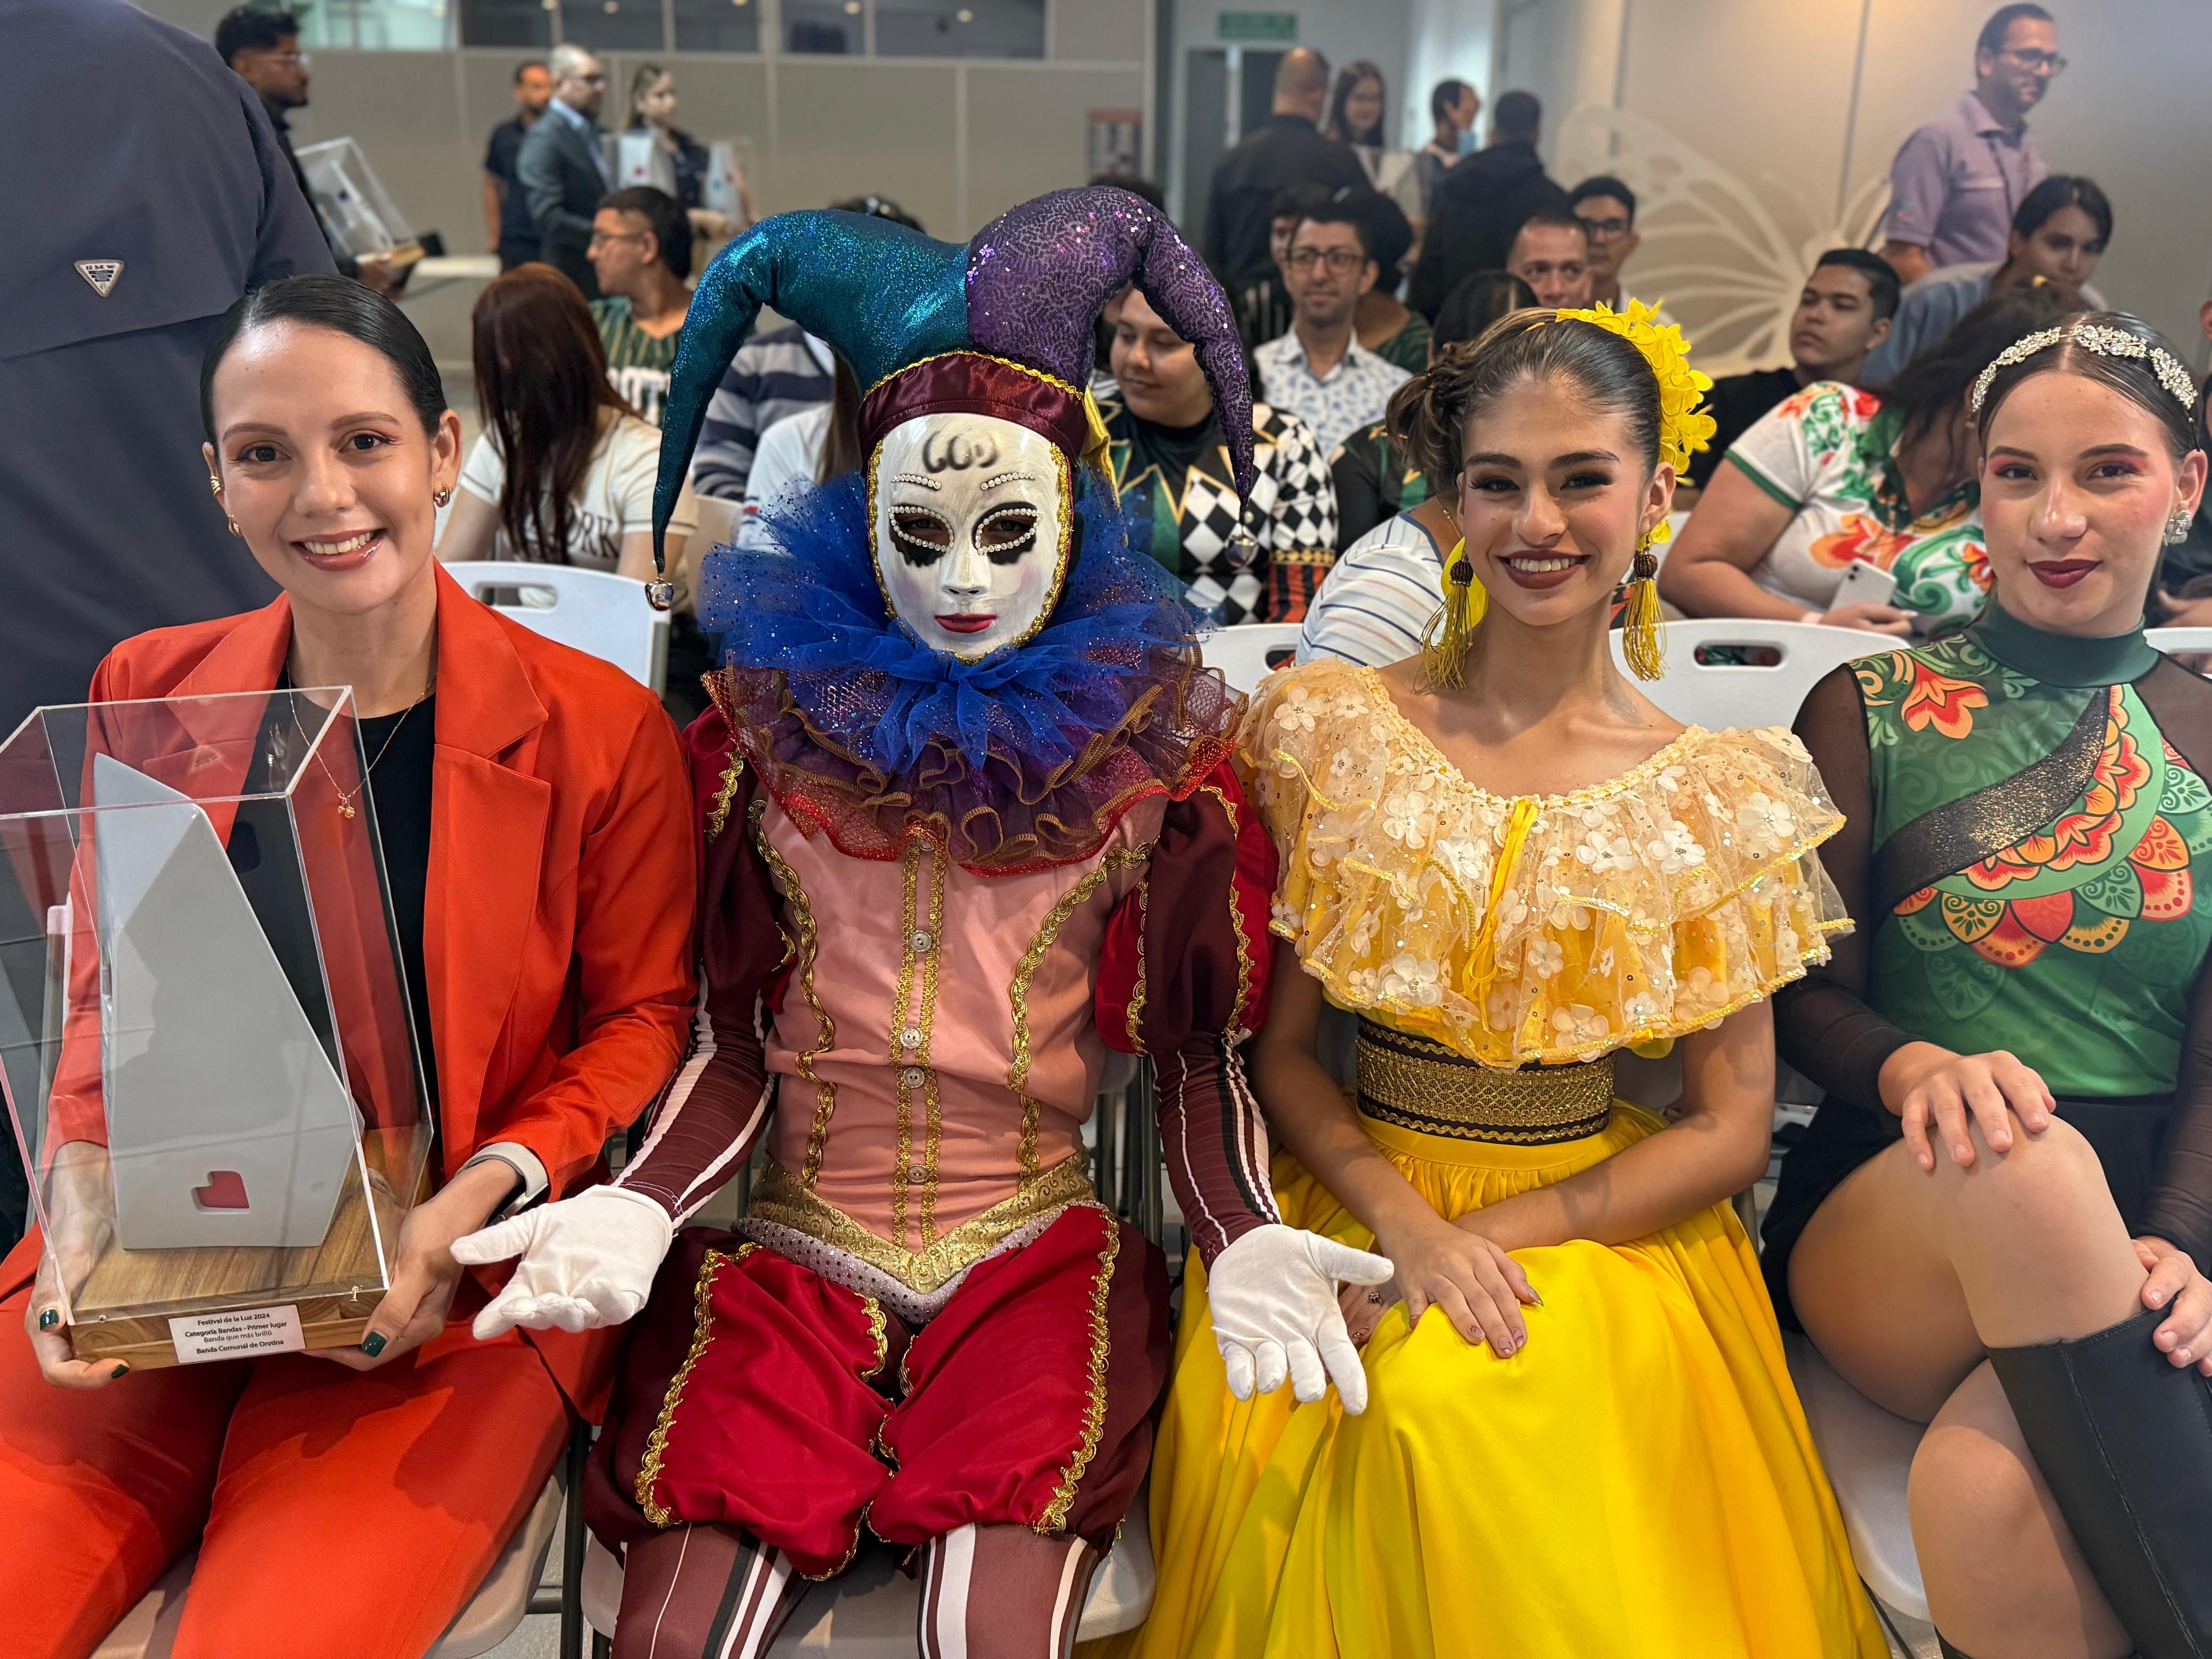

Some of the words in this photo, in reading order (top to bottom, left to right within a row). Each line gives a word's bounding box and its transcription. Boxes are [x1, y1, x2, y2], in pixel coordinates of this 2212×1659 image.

[197, 1317, 222, 1326] Festival
[185, 1329, 217, 1337] Categoría
[219, 1342, 248, 1351] Comunal
